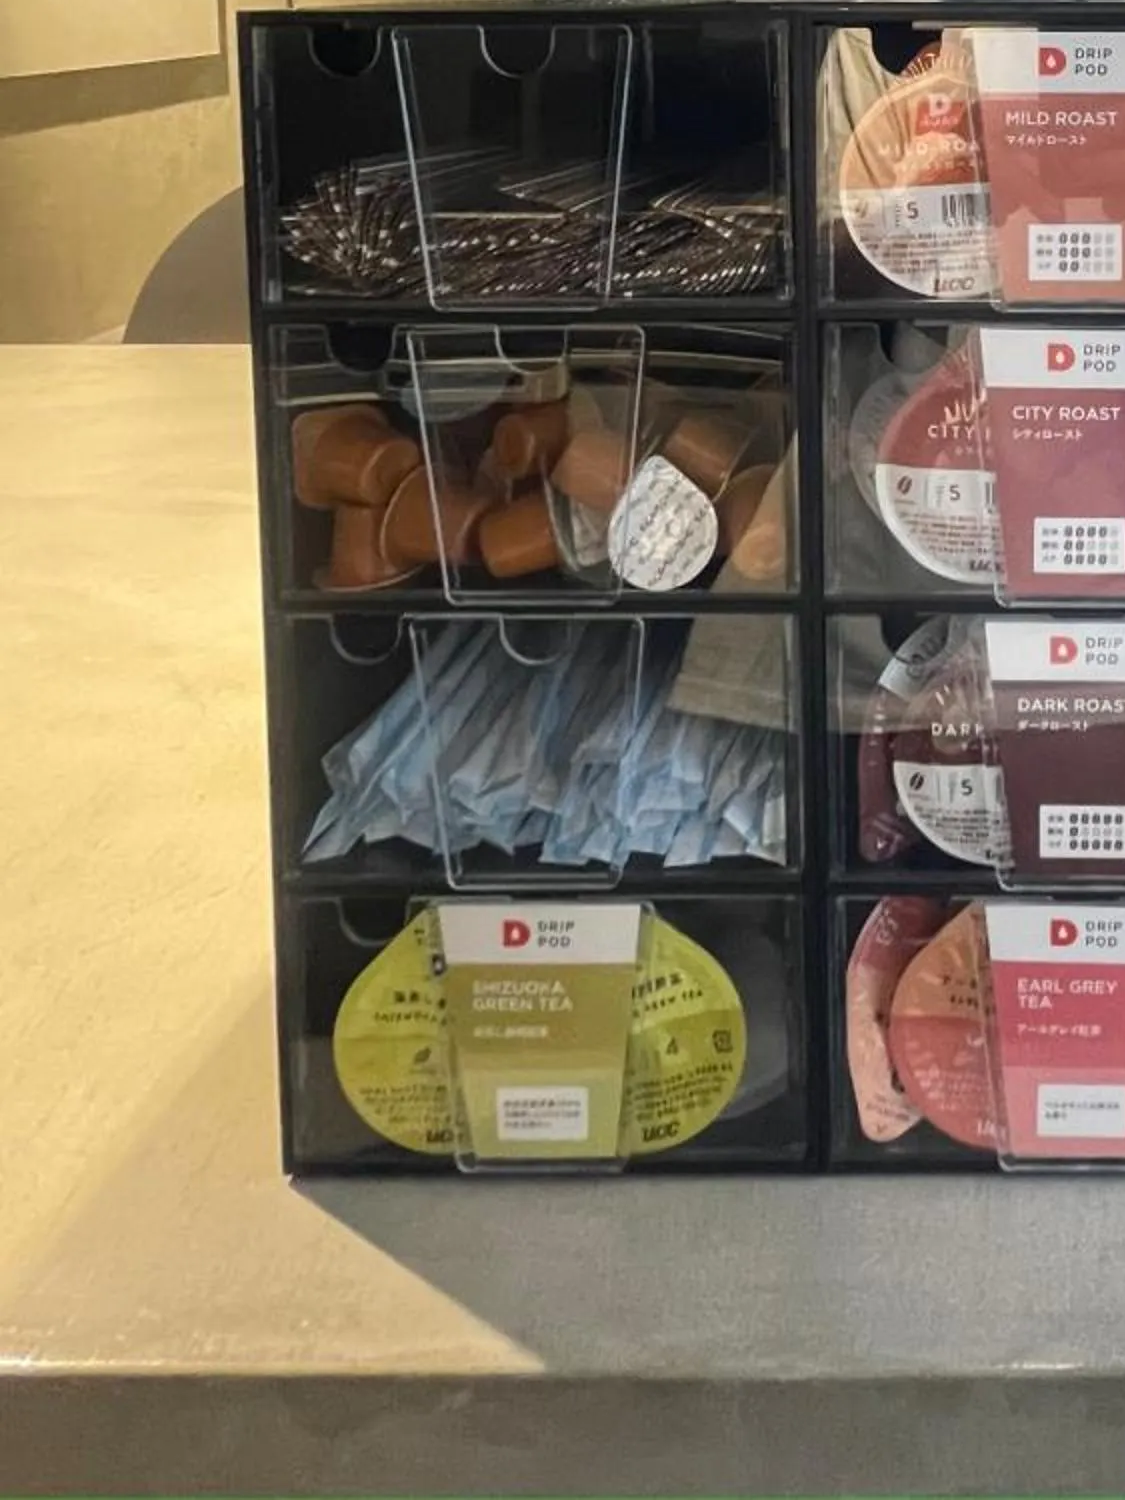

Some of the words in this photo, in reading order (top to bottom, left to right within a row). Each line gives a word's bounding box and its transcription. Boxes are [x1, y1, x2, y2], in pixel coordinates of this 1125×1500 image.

[1075, 47, 1113, 59] DRIP
[1075, 63, 1108, 76] POD
[1005, 111, 1050, 126] MILD
[1055, 111, 1118, 126] ROAST
[1083, 344, 1121, 356] DRIP
[1083, 359, 1117, 372] POD
[1012, 406, 1053, 421] CITY
[1059, 406, 1121, 421] ROAST
[928, 425, 975, 439] CITY
[1085, 637, 1123, 649] DRIP
[1085, 653, 1119, 665] POD
[1017, 698, 1068, 713] DARK
[538, 920, 575, 932] DRIP
[1085, 921, 1122, 933] DRIP
[538, 936, 571, 948] POD
[1085, 936, 1118, 948] POD
[1017, 978, 1064, 994] EARL
[1069, 980, 1118, 995] GREY
[472, 996, 533, 1012] GREEN
[539, 996, 574, 1012] TEA
[1018, 995, 1053, 1010] TEA
